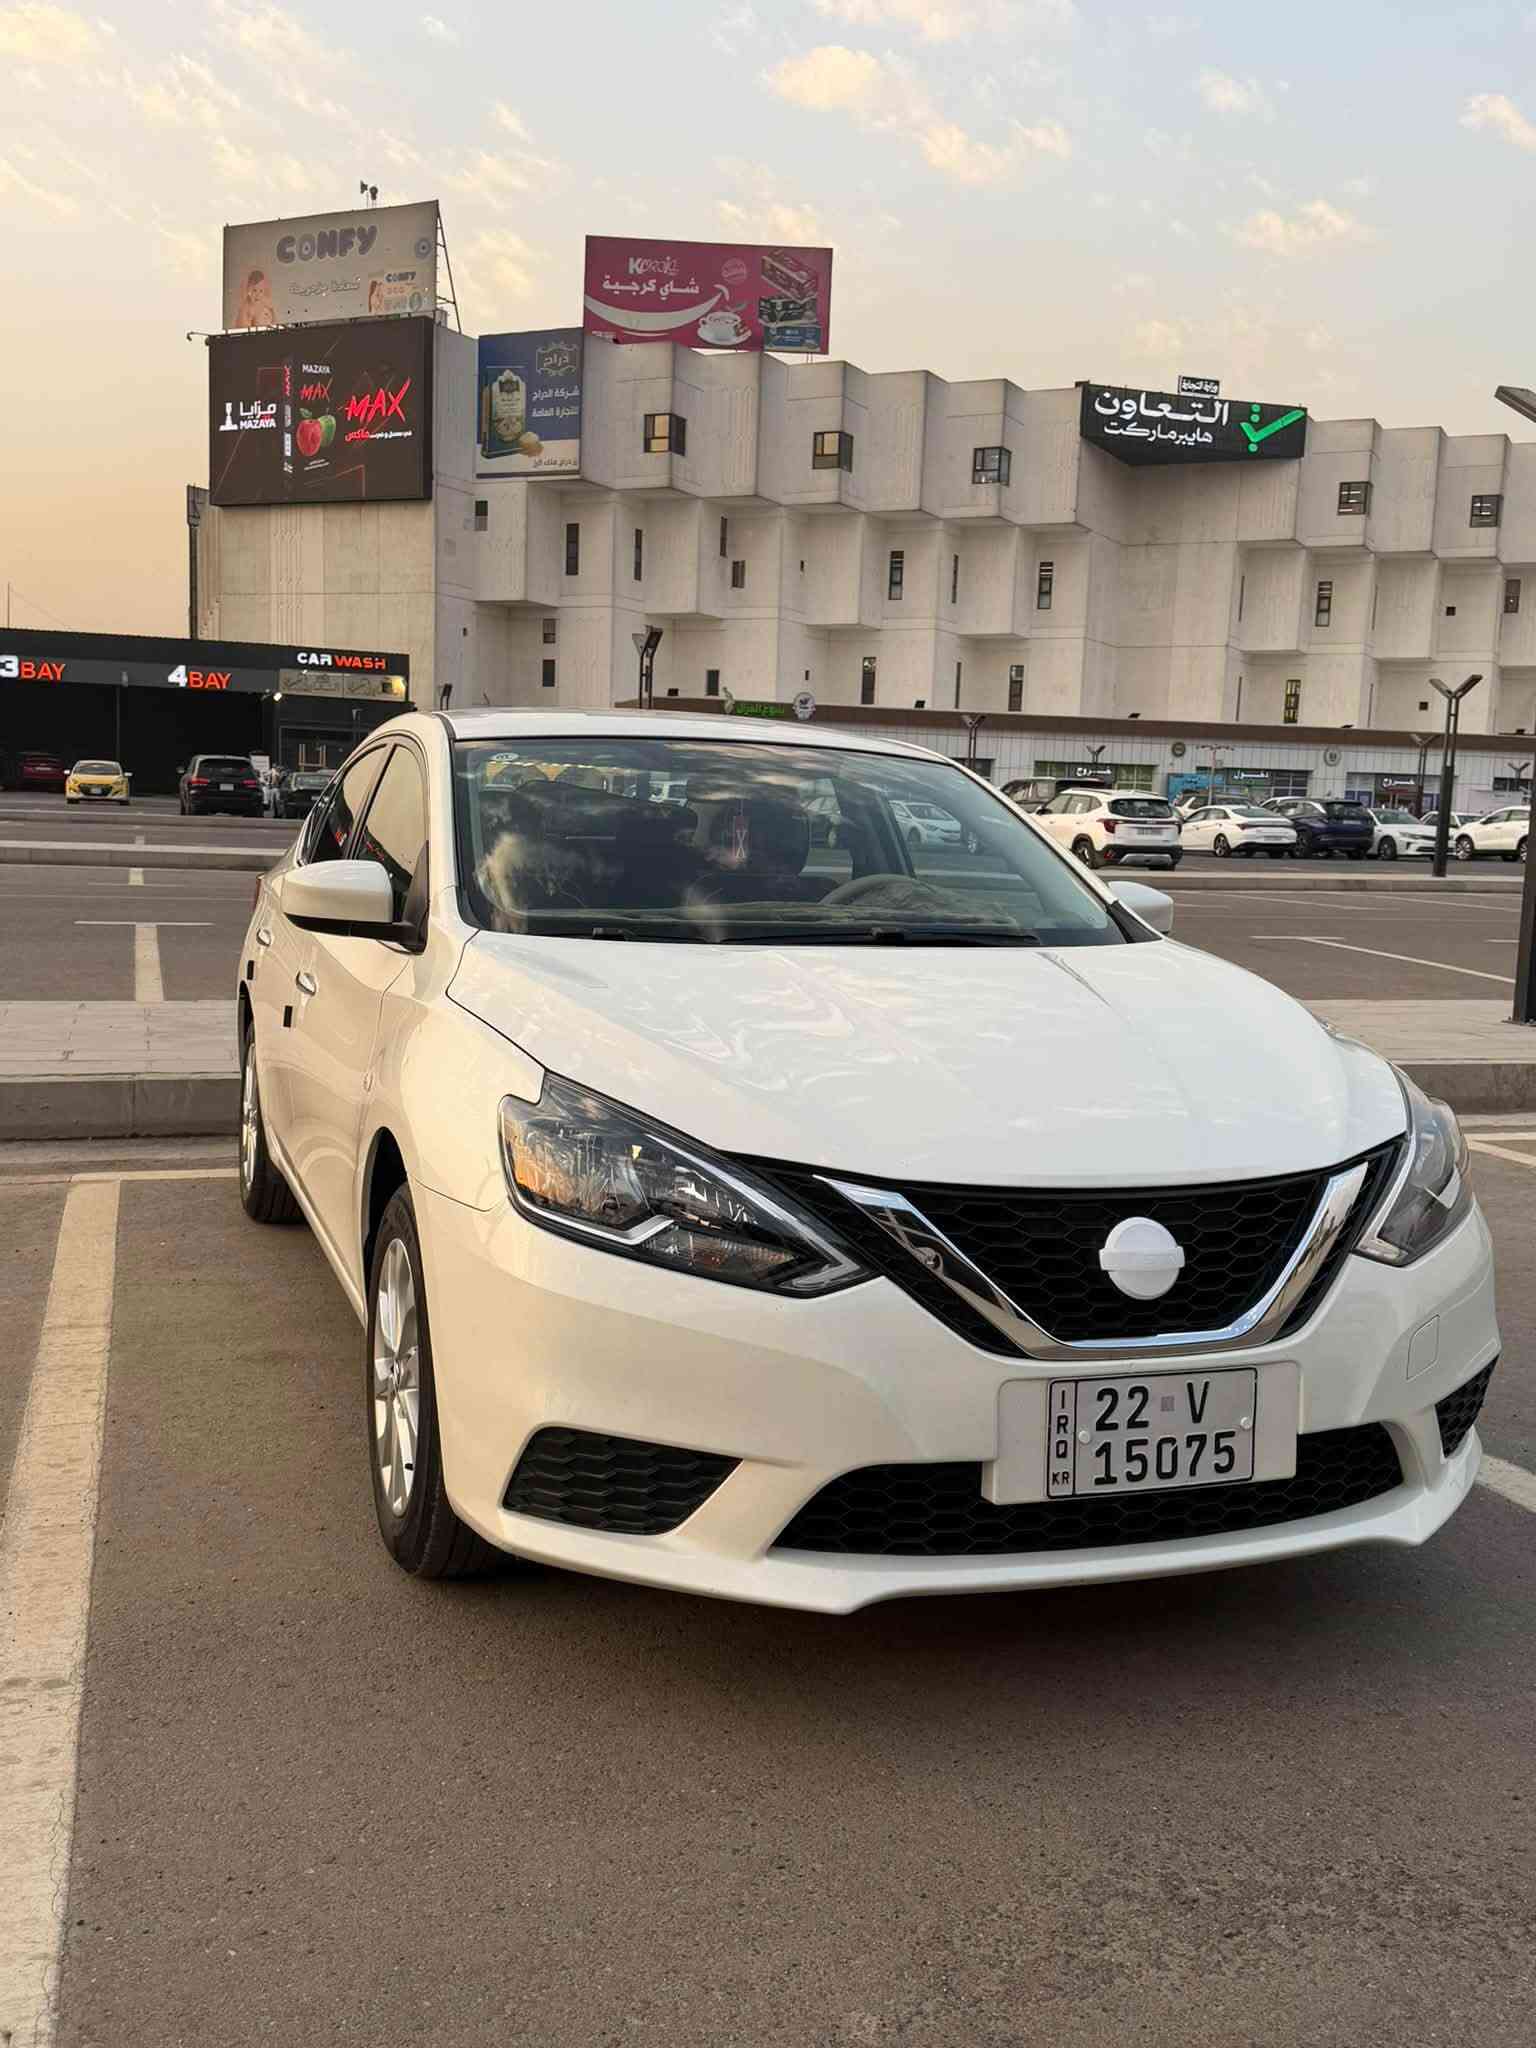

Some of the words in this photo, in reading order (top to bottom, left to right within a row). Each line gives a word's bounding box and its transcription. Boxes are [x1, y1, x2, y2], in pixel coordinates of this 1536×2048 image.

[277, 225, 378, 264] CONFY
[658, 278, 700, 301] شاي
[302, 363, 332, 374] MAZAYA
[300, 377, 334, 402] MAX
[345, 375, 412, 423] MAX
[239, 400, 277, 419] مزايا
[1094, 391, 1230, 426] التعاون
[239, 418, 277, 430] MAZAYA
[1103, 421, 1214, 445] هايبرماركت
[296, 652, 333, 666] CAR
[334, 655, 386, 670] WASH
[1095, 1386, 1150, 1432] 22
[1186, 1380, 1211, 1425] V
[1094, 1430, 1237, 1486] 15075
[1051, 1471, 1071, 1487] KR
